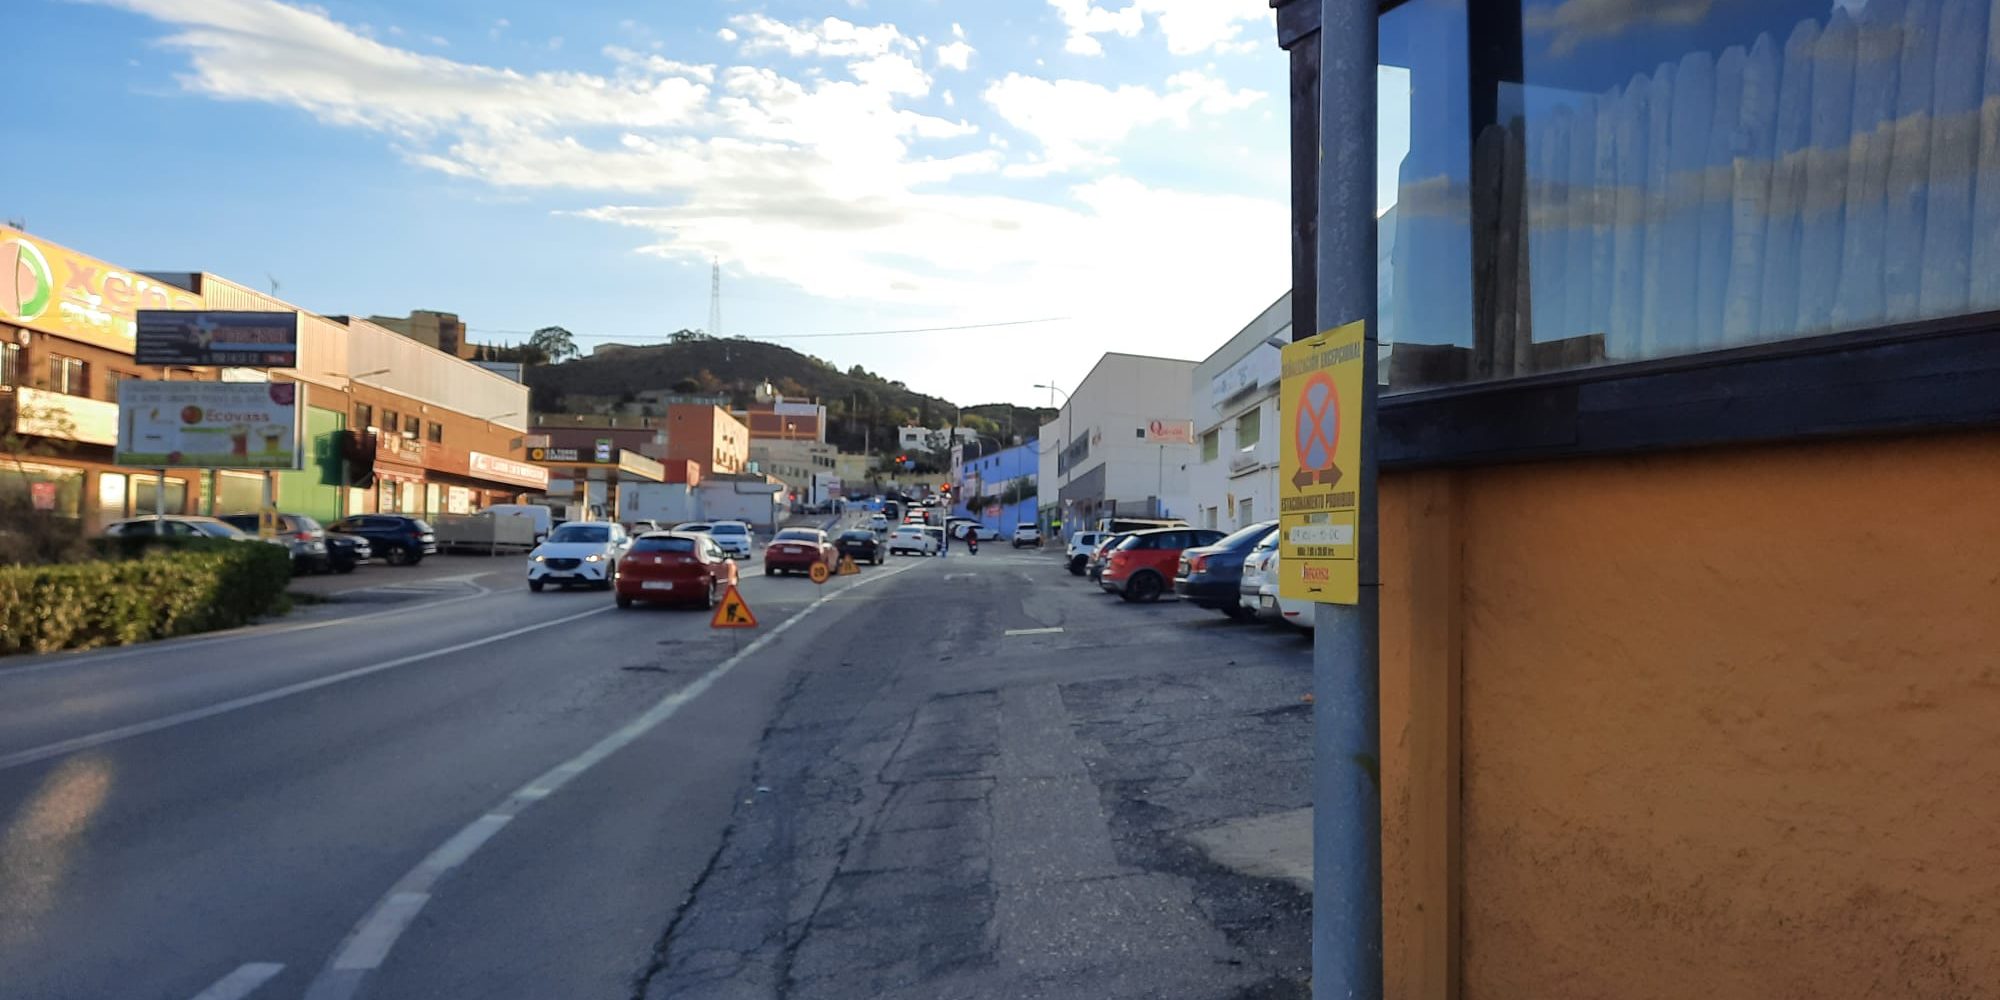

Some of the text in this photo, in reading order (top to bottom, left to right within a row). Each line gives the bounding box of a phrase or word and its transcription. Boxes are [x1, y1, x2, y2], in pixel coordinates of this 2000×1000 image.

[206, 409, 270, 423] Ecovass
[1281, 491, 1355, 511] ESTACIONAMIENTO PROHIBIDO
